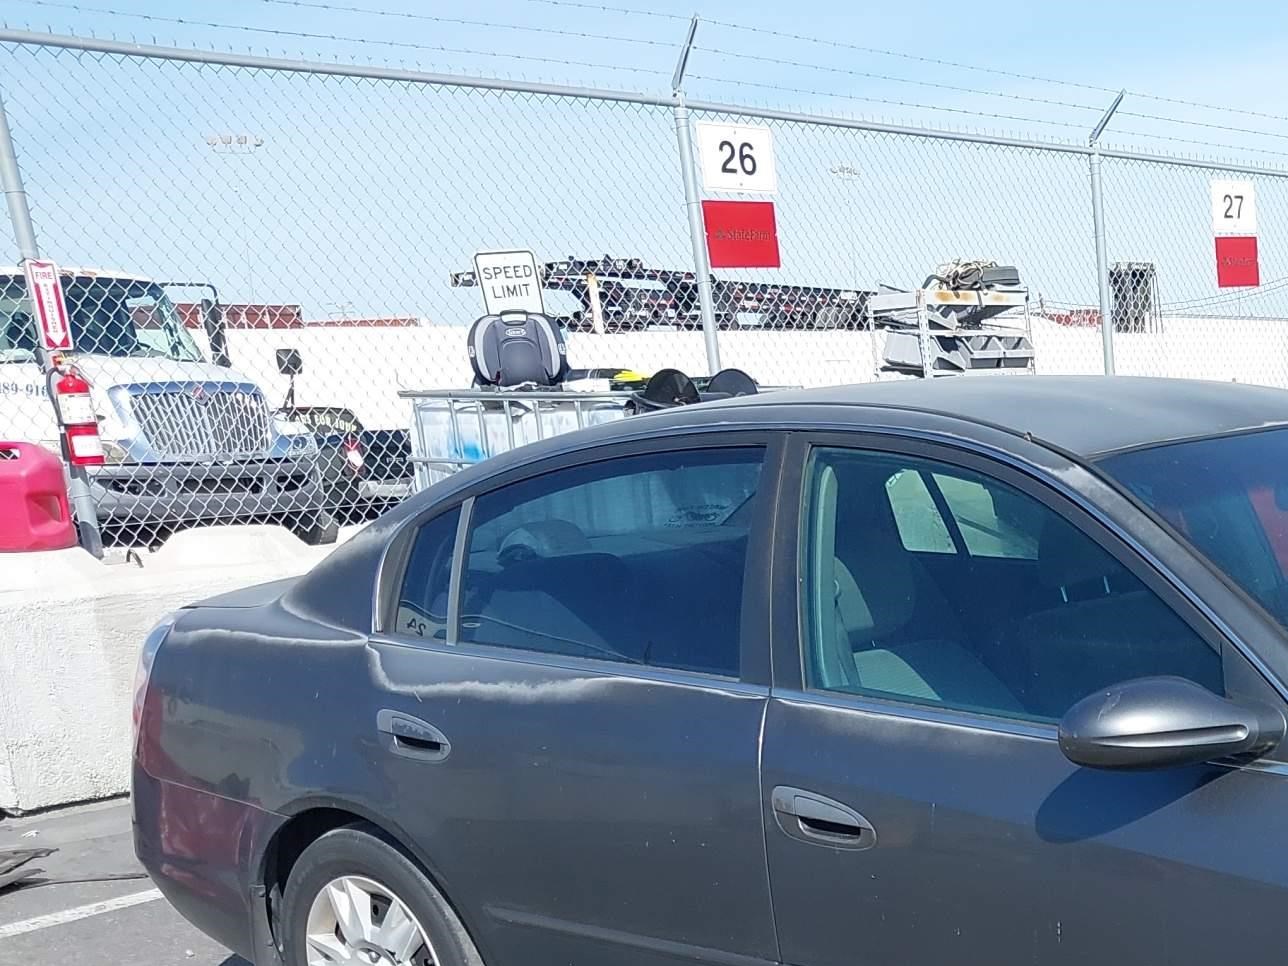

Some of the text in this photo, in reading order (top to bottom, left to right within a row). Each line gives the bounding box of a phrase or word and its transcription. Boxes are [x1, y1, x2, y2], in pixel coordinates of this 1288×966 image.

[718, 140, 757, 176] 26
[1223, 194, 1244, 219] 27
[34, 271, 53, 280] FIRE
[482, 265, 533, 281] SPEED
[491, 284, 531, 299] LIMIT
